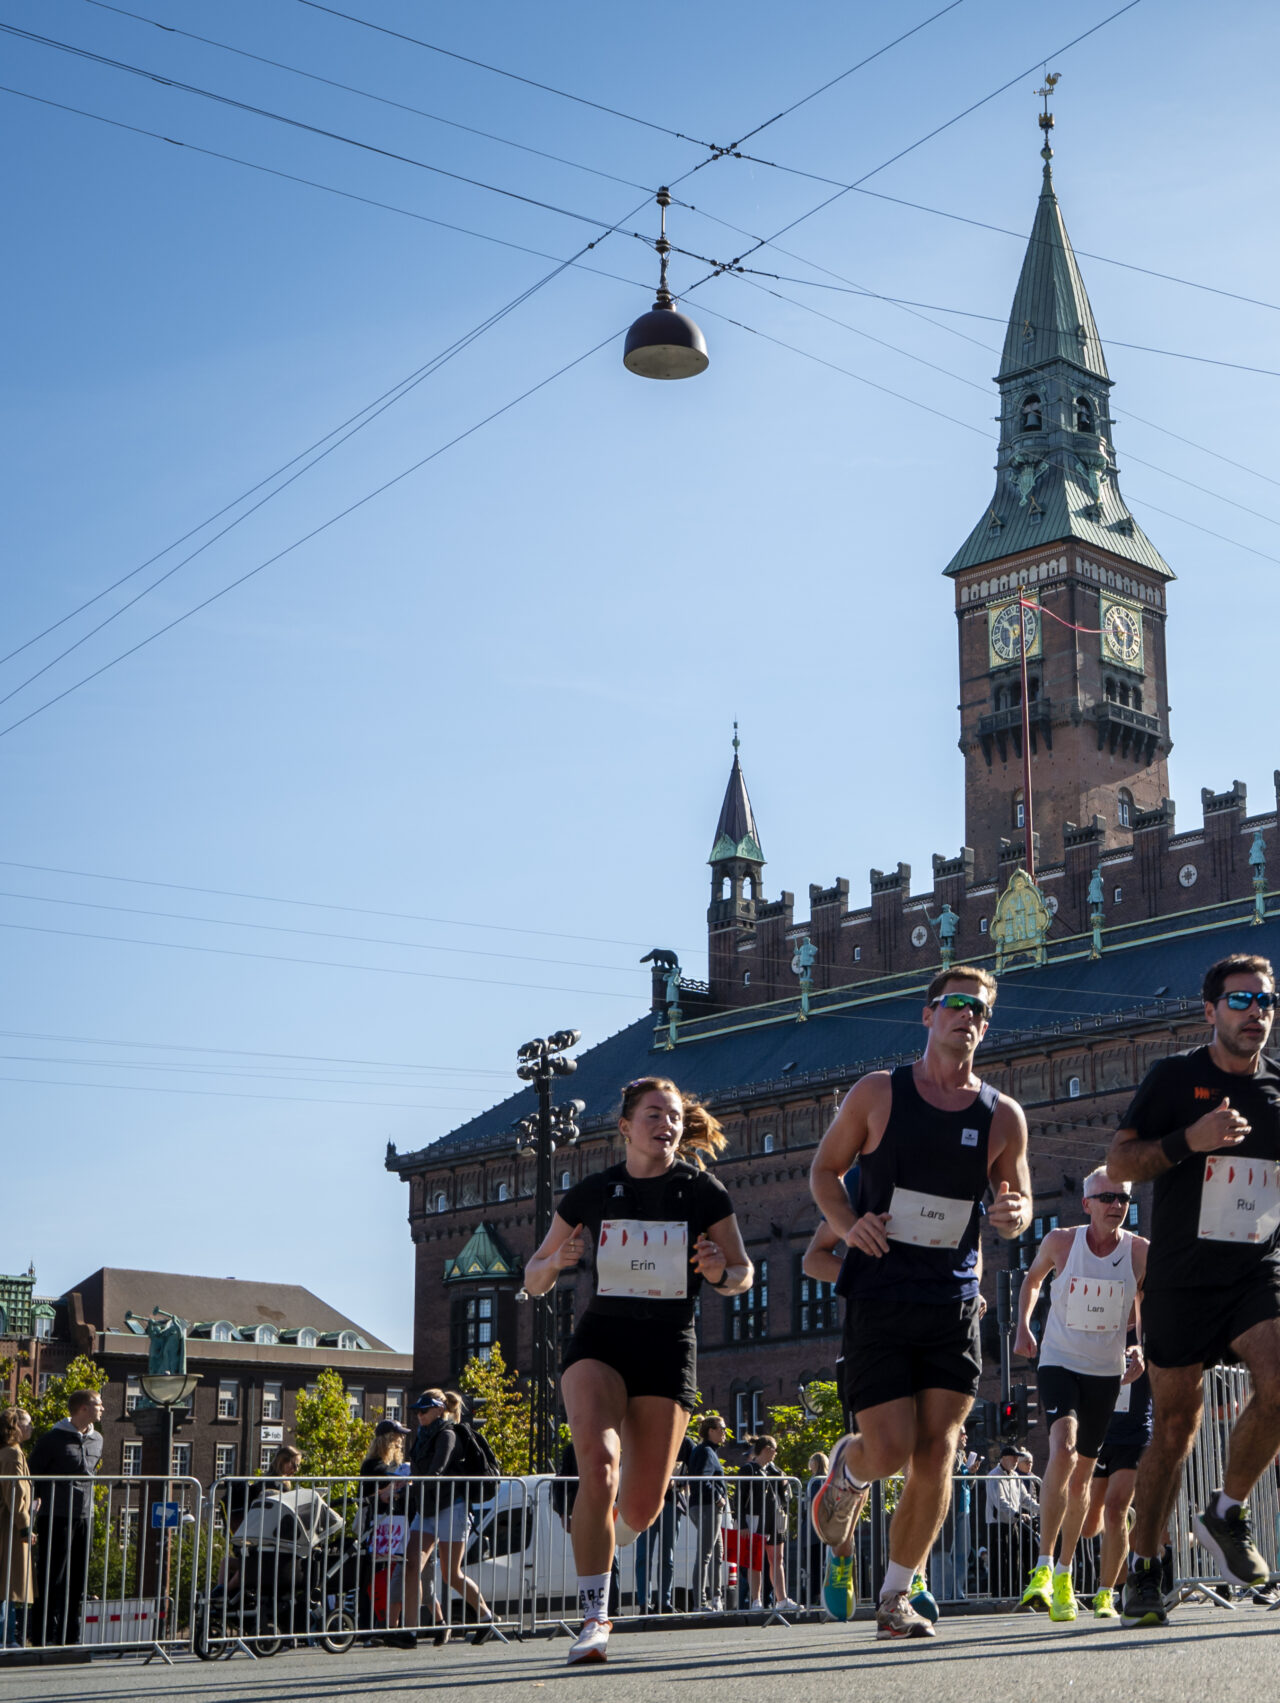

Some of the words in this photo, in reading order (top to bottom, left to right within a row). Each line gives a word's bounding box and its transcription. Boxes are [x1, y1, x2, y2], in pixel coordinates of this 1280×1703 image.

[1236, 1198, 1256, 1211] Rui
[920, 1206, 945, 1220] Lars
[630, 1259, 656, 1271] Erin
[1087, 1304, 1105, 1313] Lars
